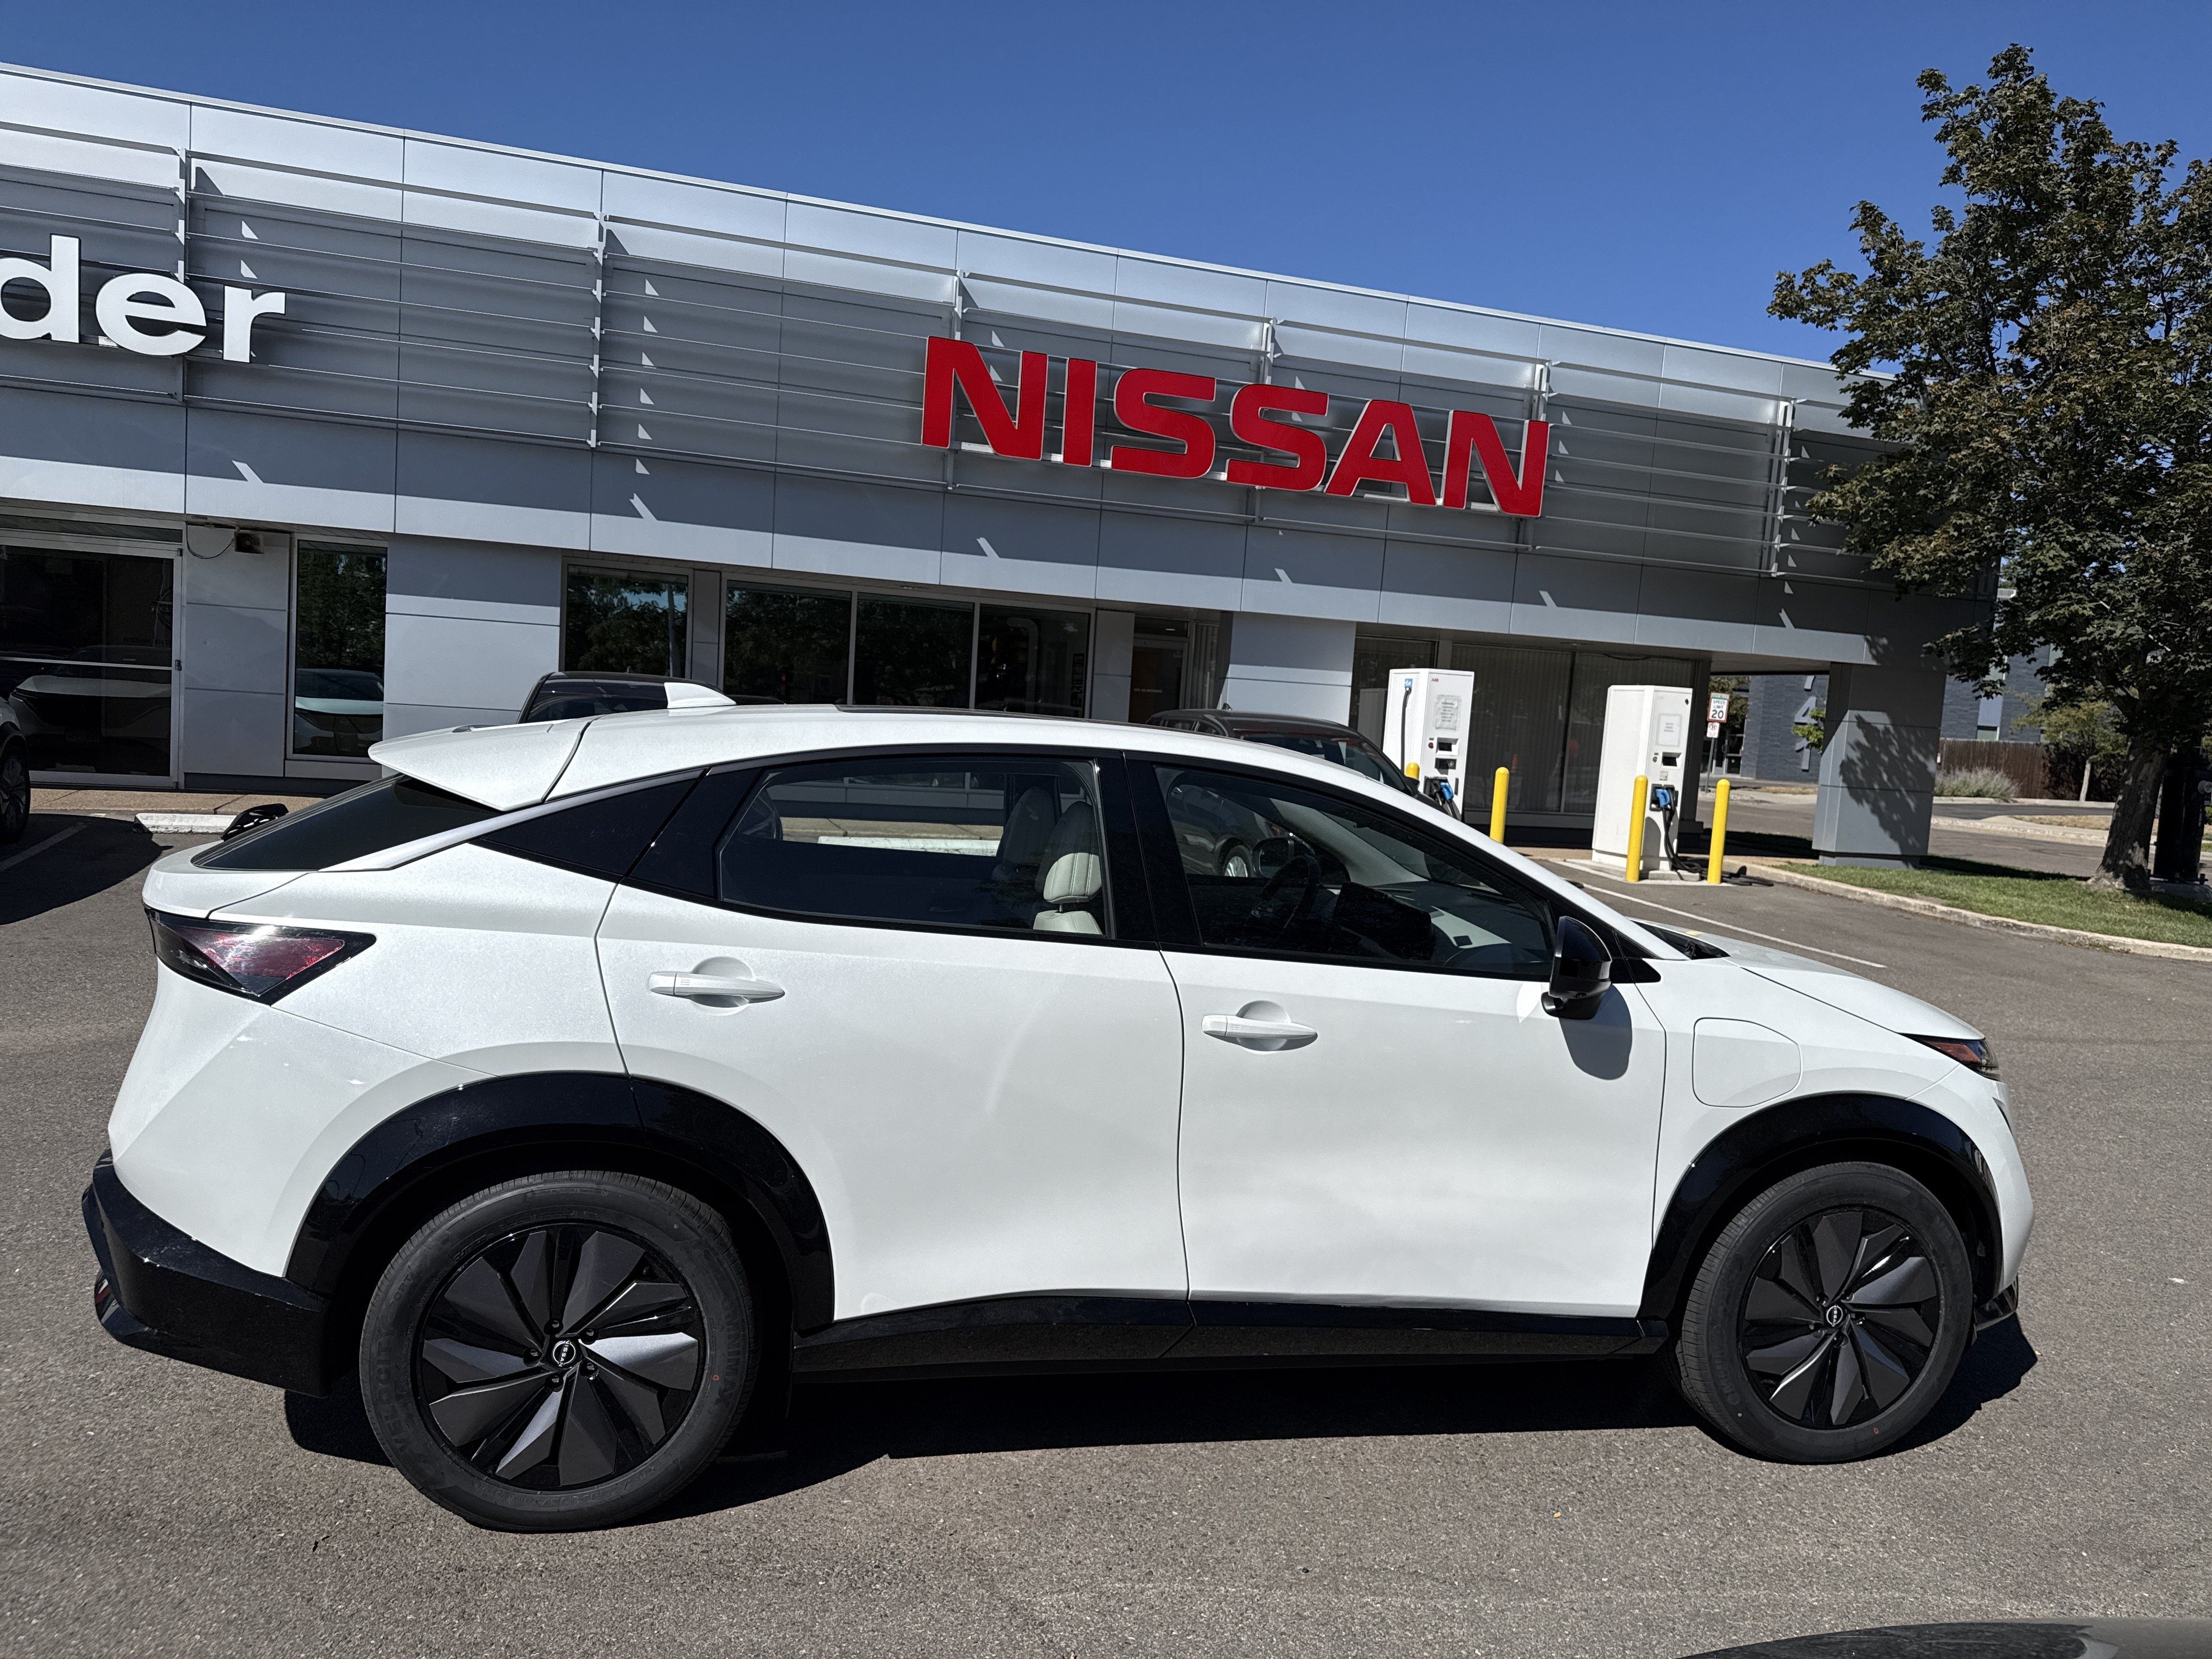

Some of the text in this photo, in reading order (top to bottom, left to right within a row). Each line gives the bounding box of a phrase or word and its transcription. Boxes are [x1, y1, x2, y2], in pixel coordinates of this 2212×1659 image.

[0, 233, 287, 364] der
[921, 335, 1550, 517] NISSAN
[1711, 709, 1724, 719] 20
[558, 1339, 570, 1367] NISSAN
